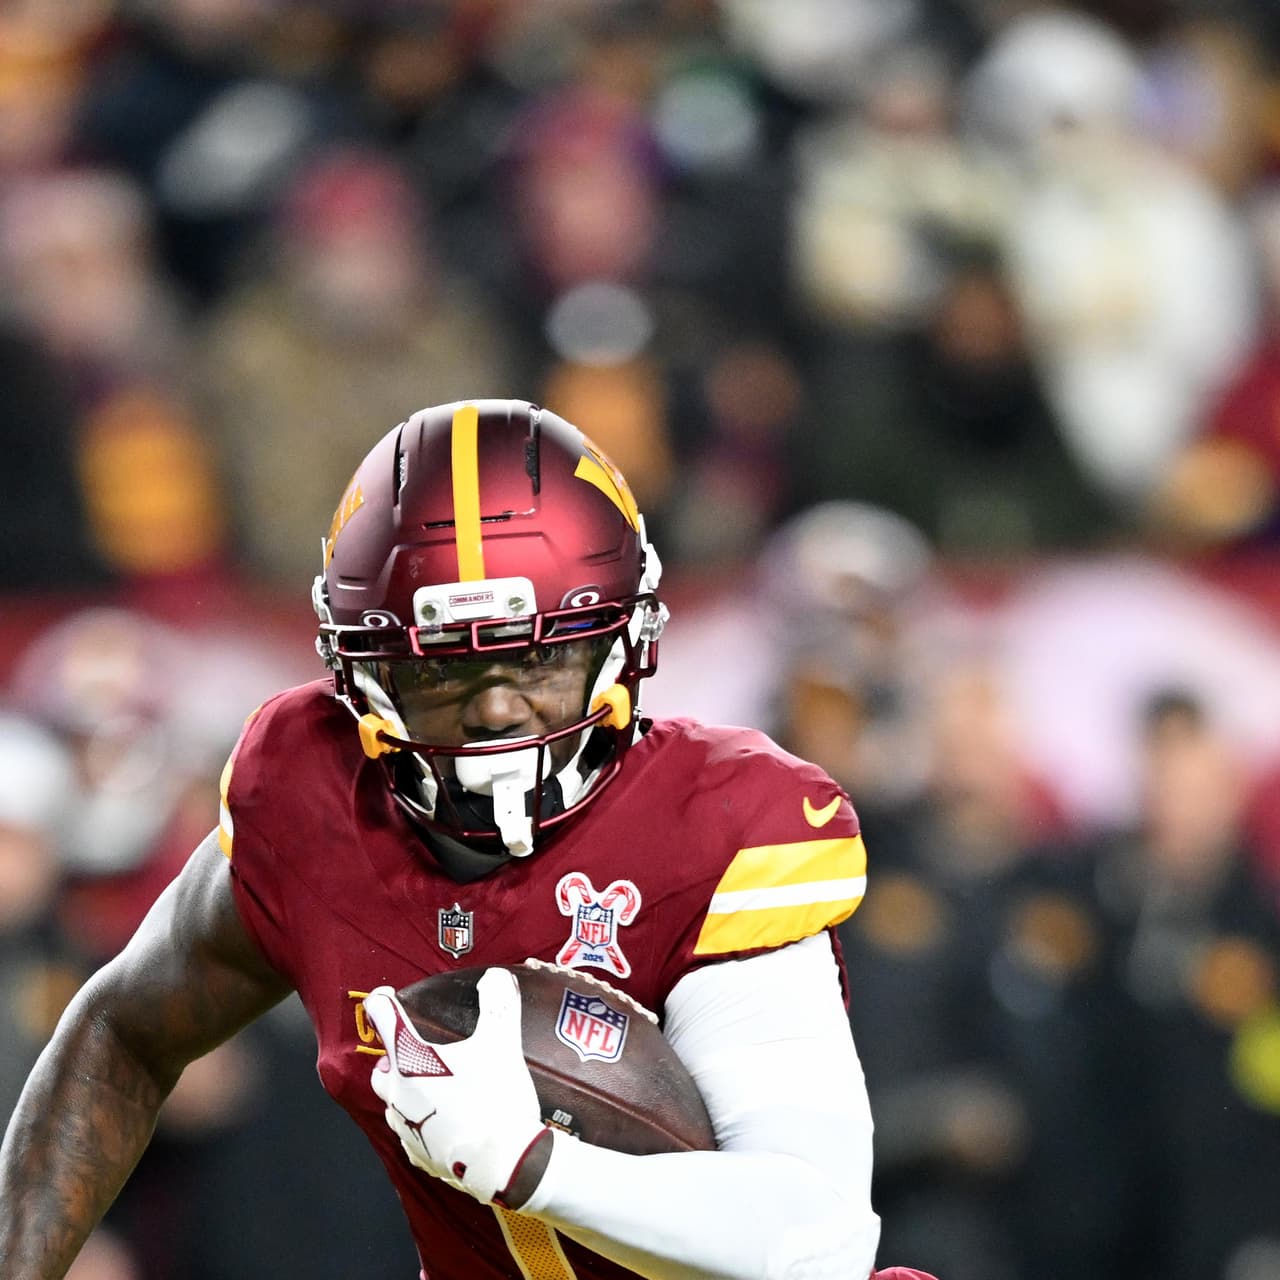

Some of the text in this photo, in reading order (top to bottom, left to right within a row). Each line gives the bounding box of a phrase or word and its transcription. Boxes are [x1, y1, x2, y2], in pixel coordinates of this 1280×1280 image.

[579, 921, 609, 943] NFL
[582, 952, 604, 963] 2025
[564, 1008, 615, 1053] NFL
